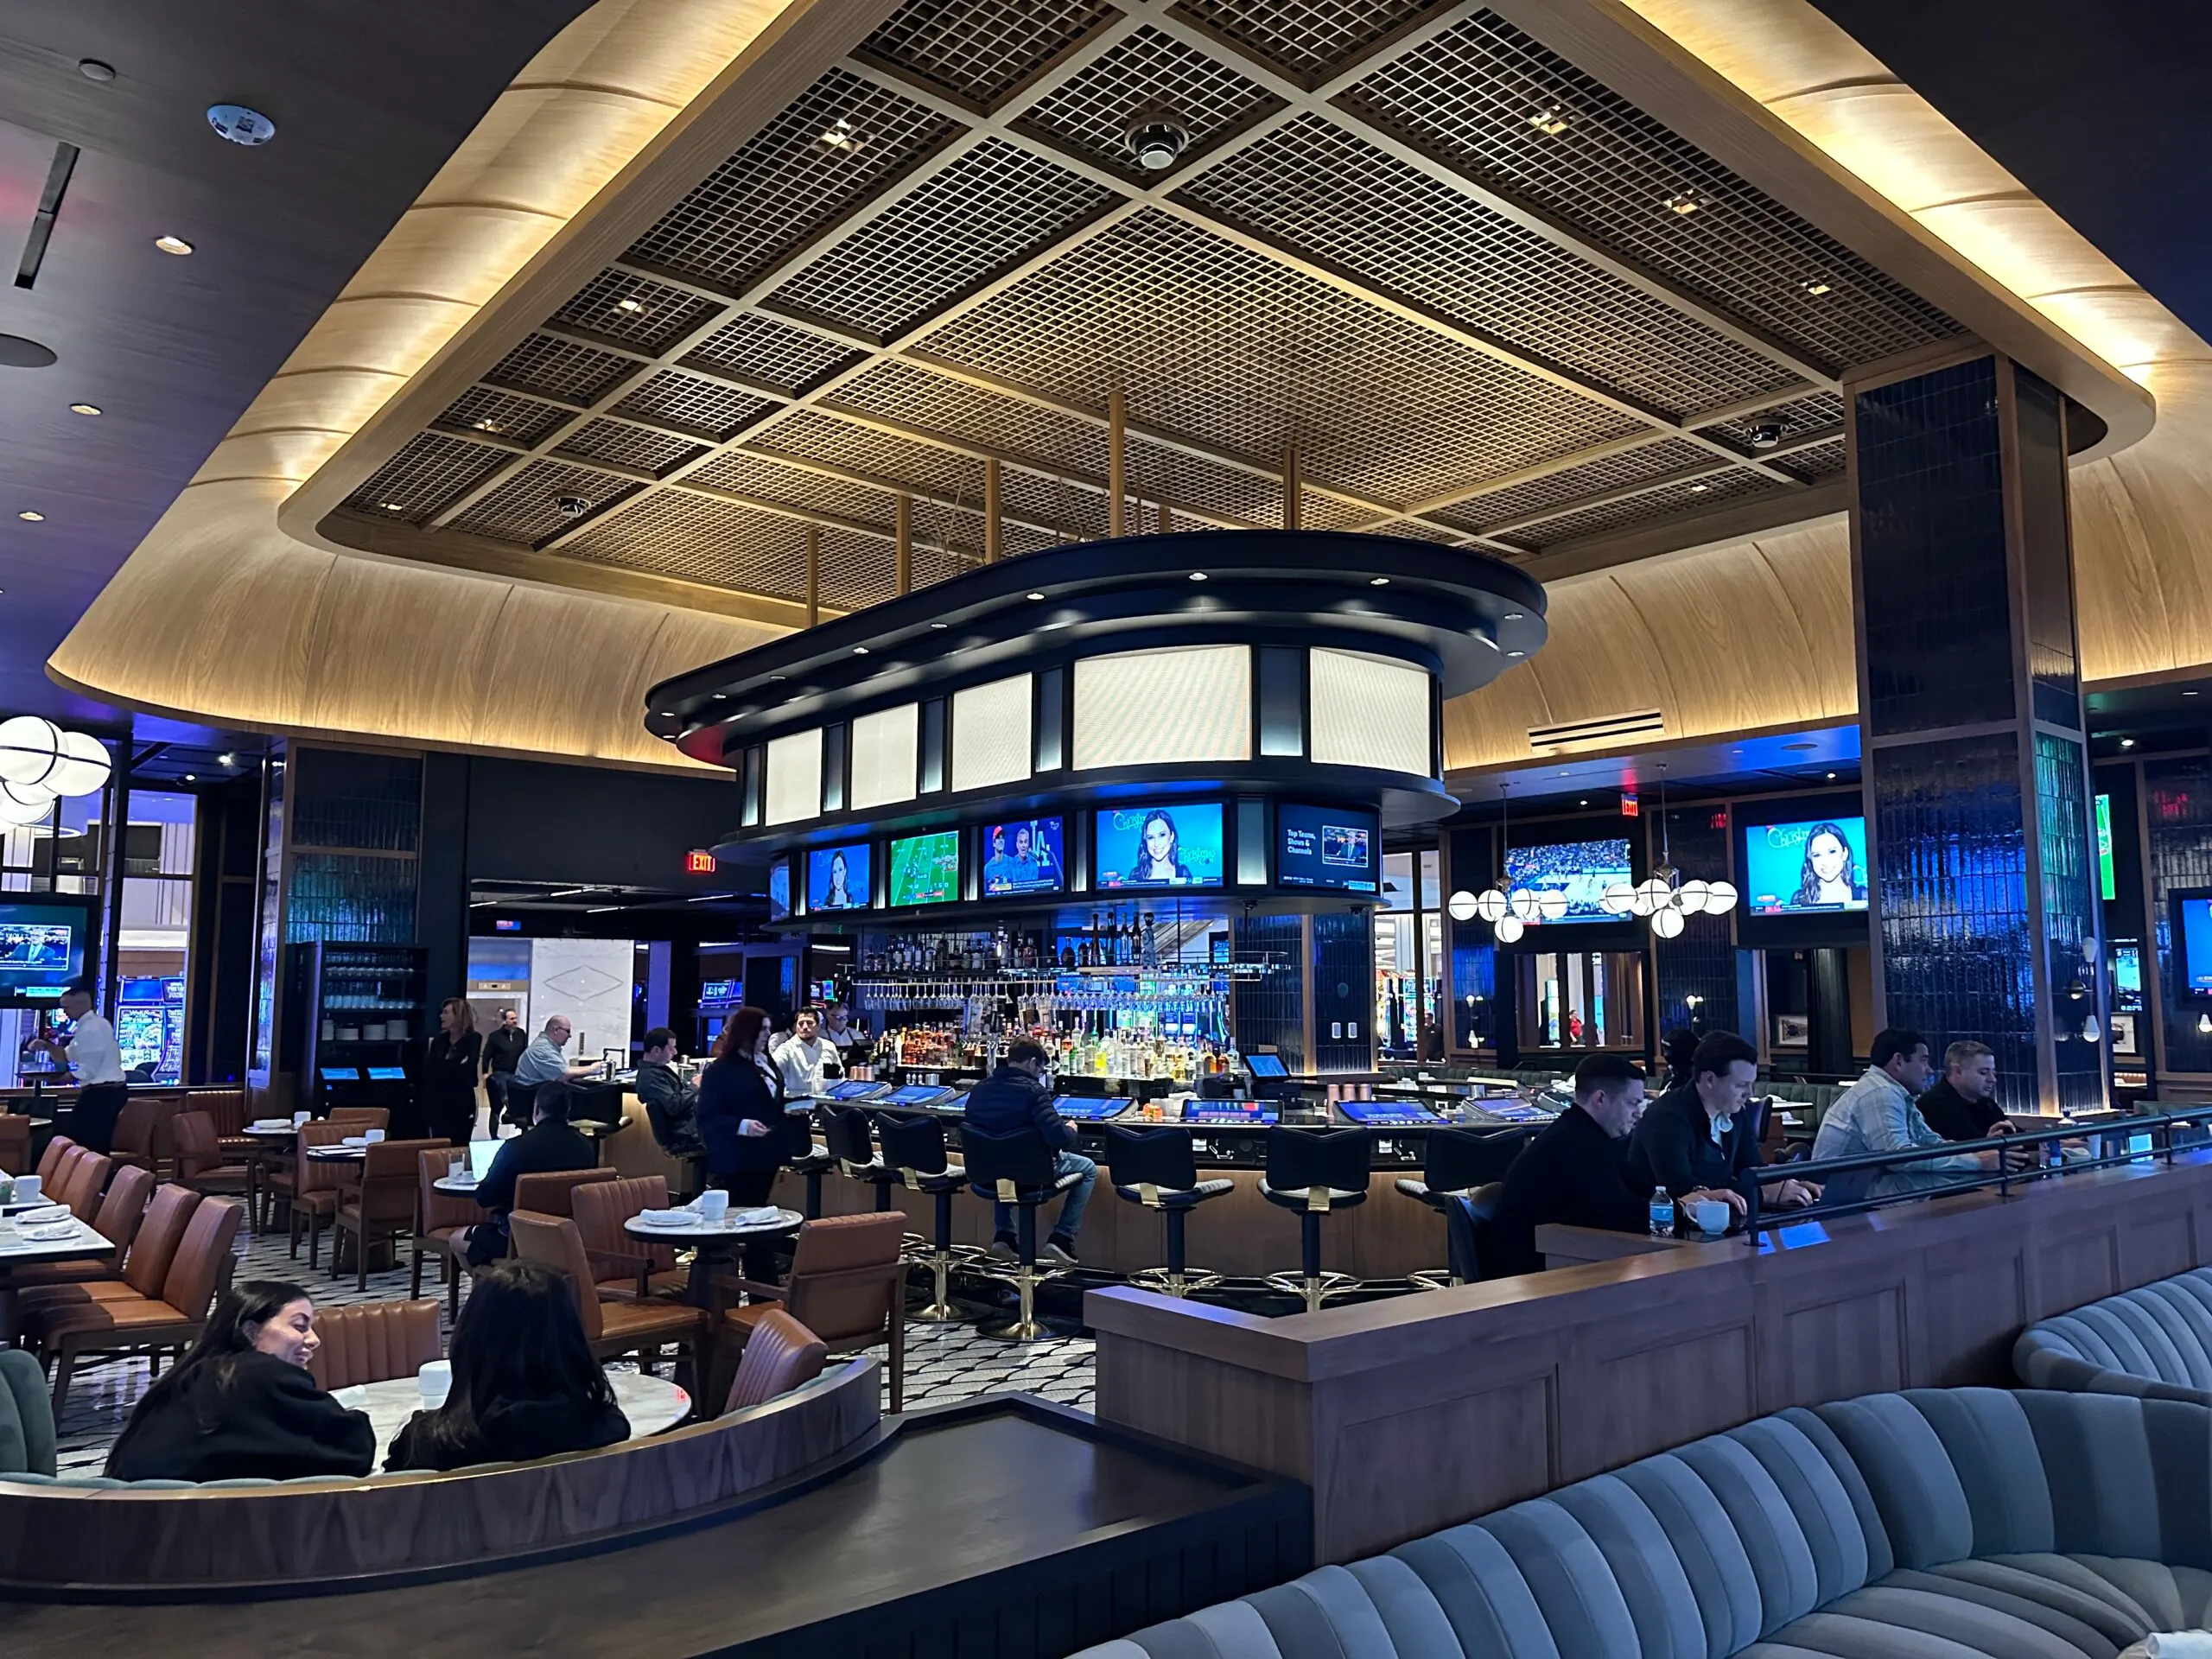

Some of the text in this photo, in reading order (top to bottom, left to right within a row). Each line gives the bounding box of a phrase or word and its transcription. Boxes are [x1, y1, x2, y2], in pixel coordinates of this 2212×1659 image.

[1624, 800, 1636, 816] EXIT
[1287, 830, 1316, 840] Top Teams,
[1287, 846, 1312, 855] Channels
[693, 854, 712, 871] EXIT
